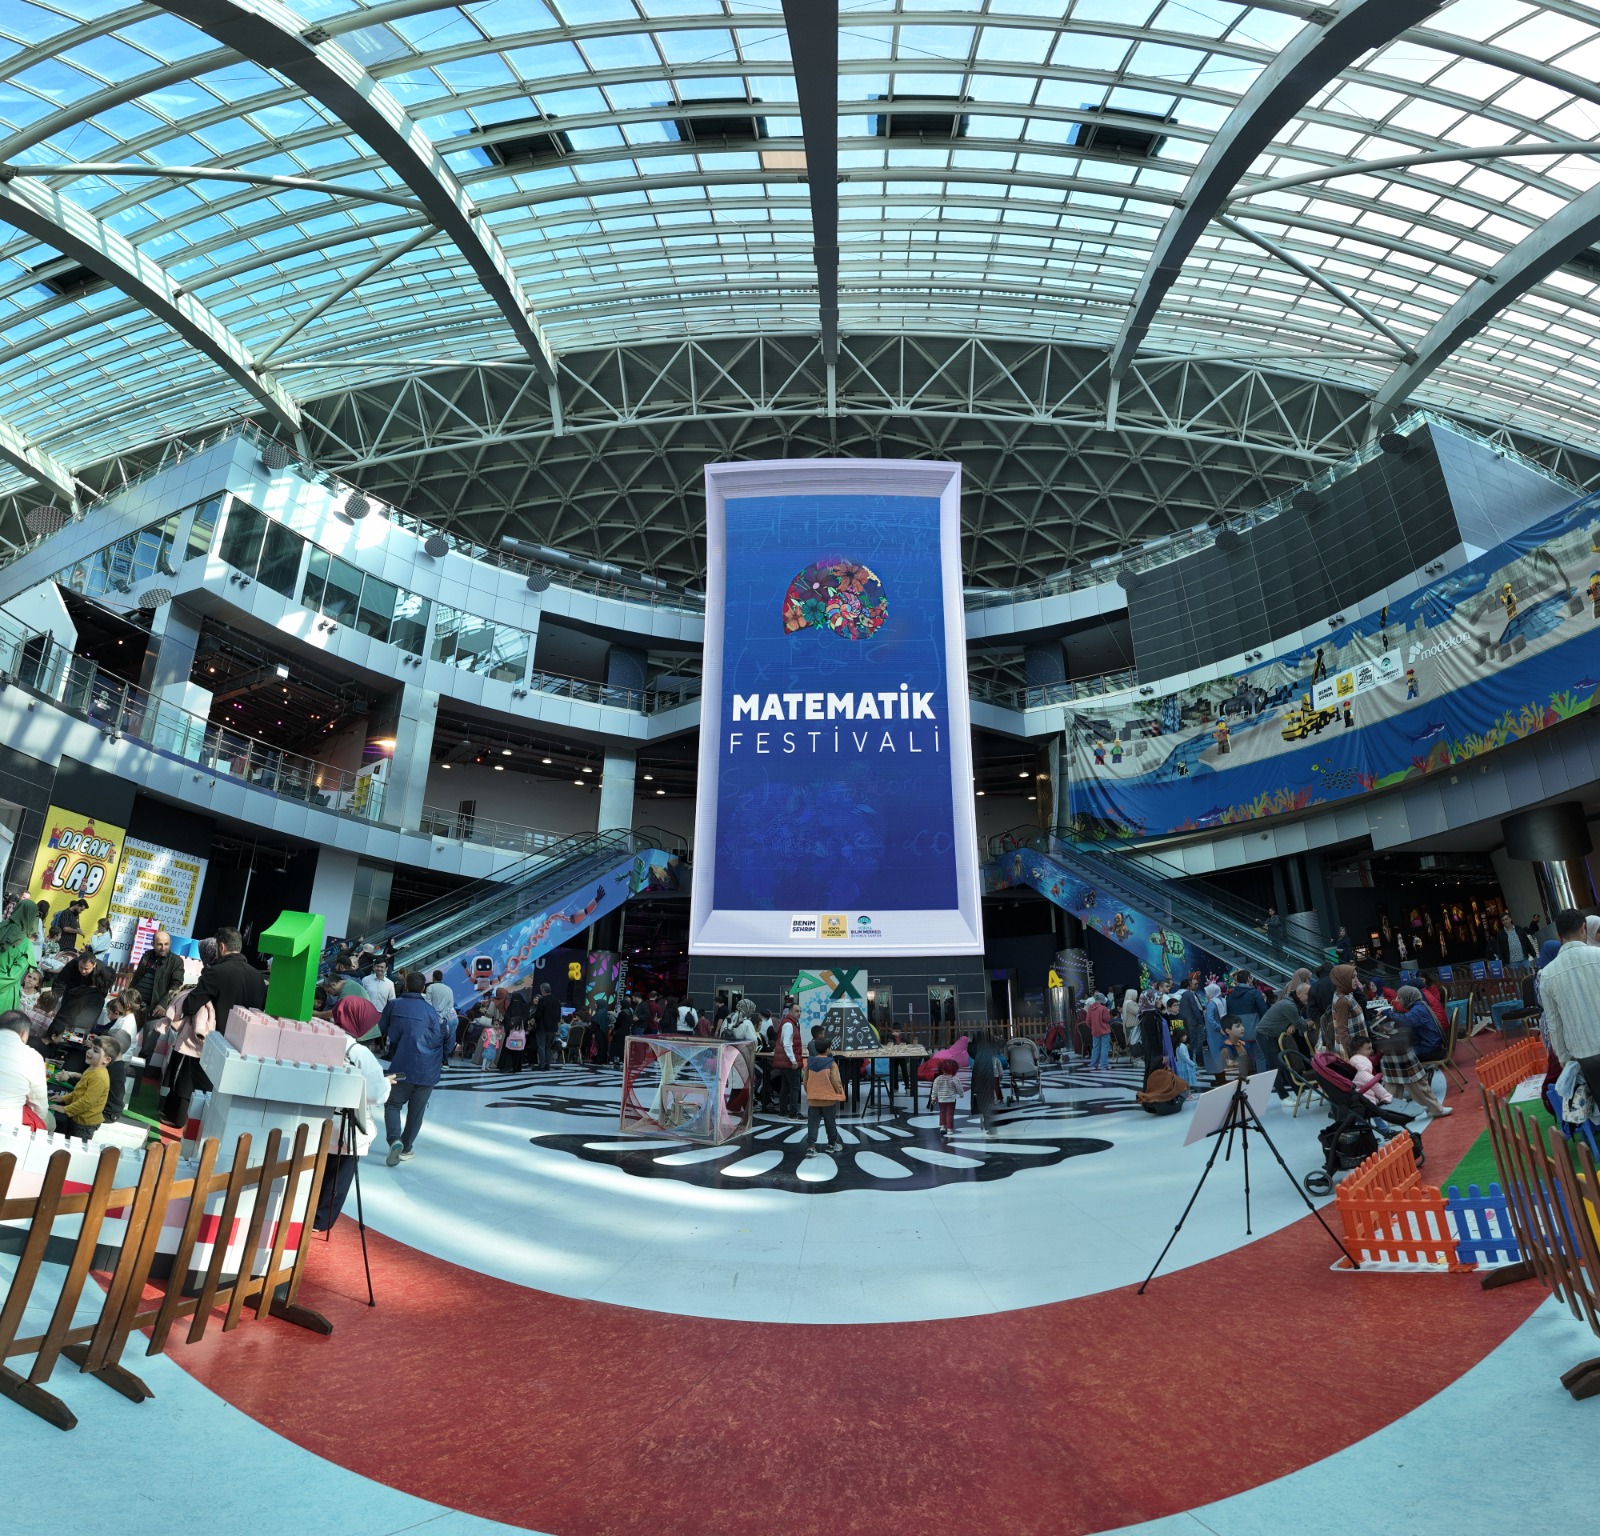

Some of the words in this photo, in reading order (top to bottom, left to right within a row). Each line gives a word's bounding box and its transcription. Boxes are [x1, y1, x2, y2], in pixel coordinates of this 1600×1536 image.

[1420, 631, 1471, 661] modekon
[732, 682, 936, 721] MATEMATİK
[730, 726, 939, 754] FESTİVALİ
[59, 830, 111, 860] DREAM
[50, 856, 105, 896] LAB
[1048, 969, 1064, 989] 4
